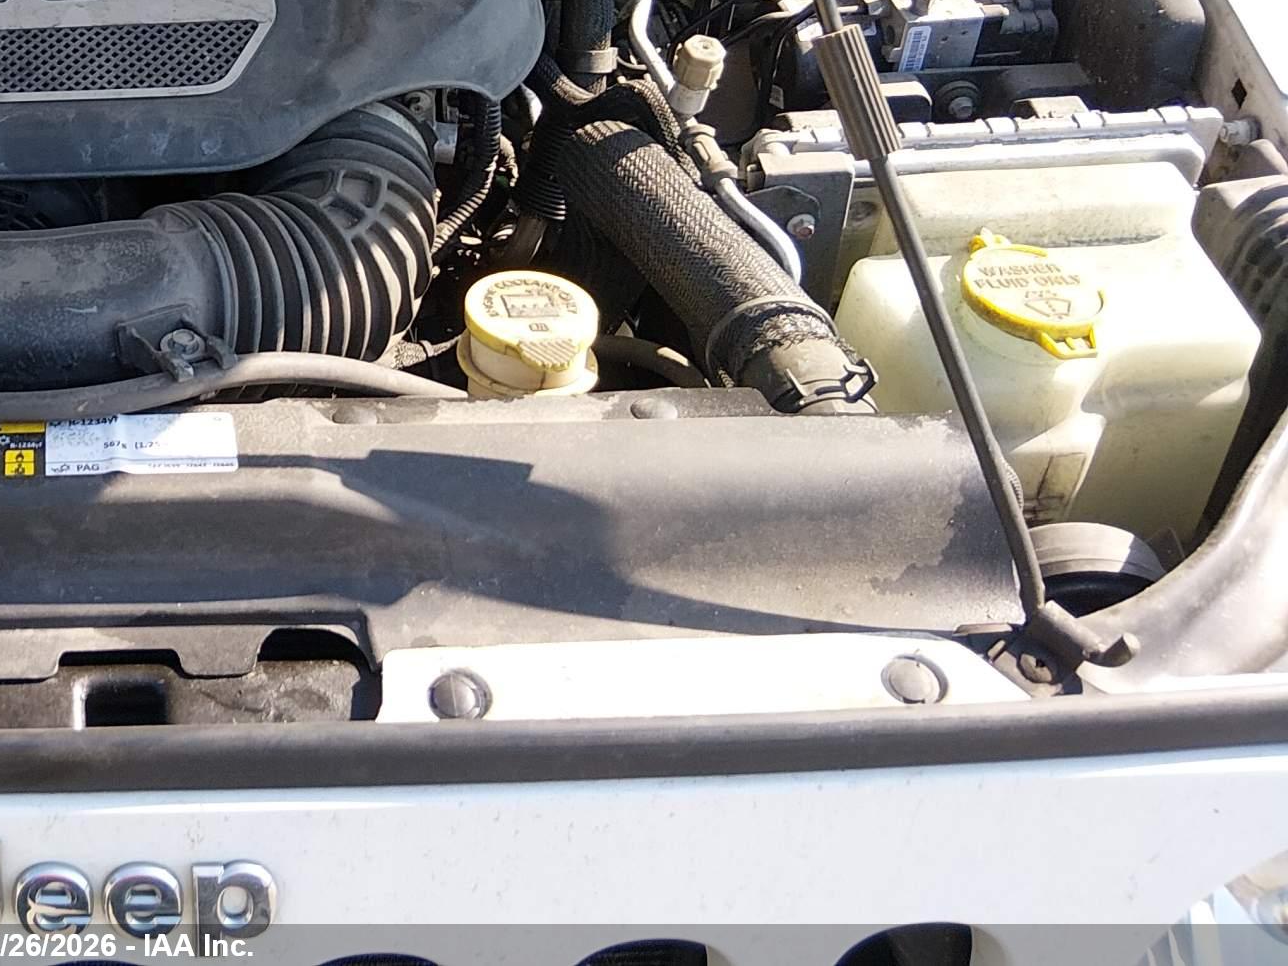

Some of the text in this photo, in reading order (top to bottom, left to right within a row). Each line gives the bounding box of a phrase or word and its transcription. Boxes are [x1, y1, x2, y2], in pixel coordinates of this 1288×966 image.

[978, 263, 1061, 277] WASHER
[494, 280, 561, 294] COOLANT
[974, 274, 1081, 289] FLUID ONLY
[75, 463, 101, 473] PAG
